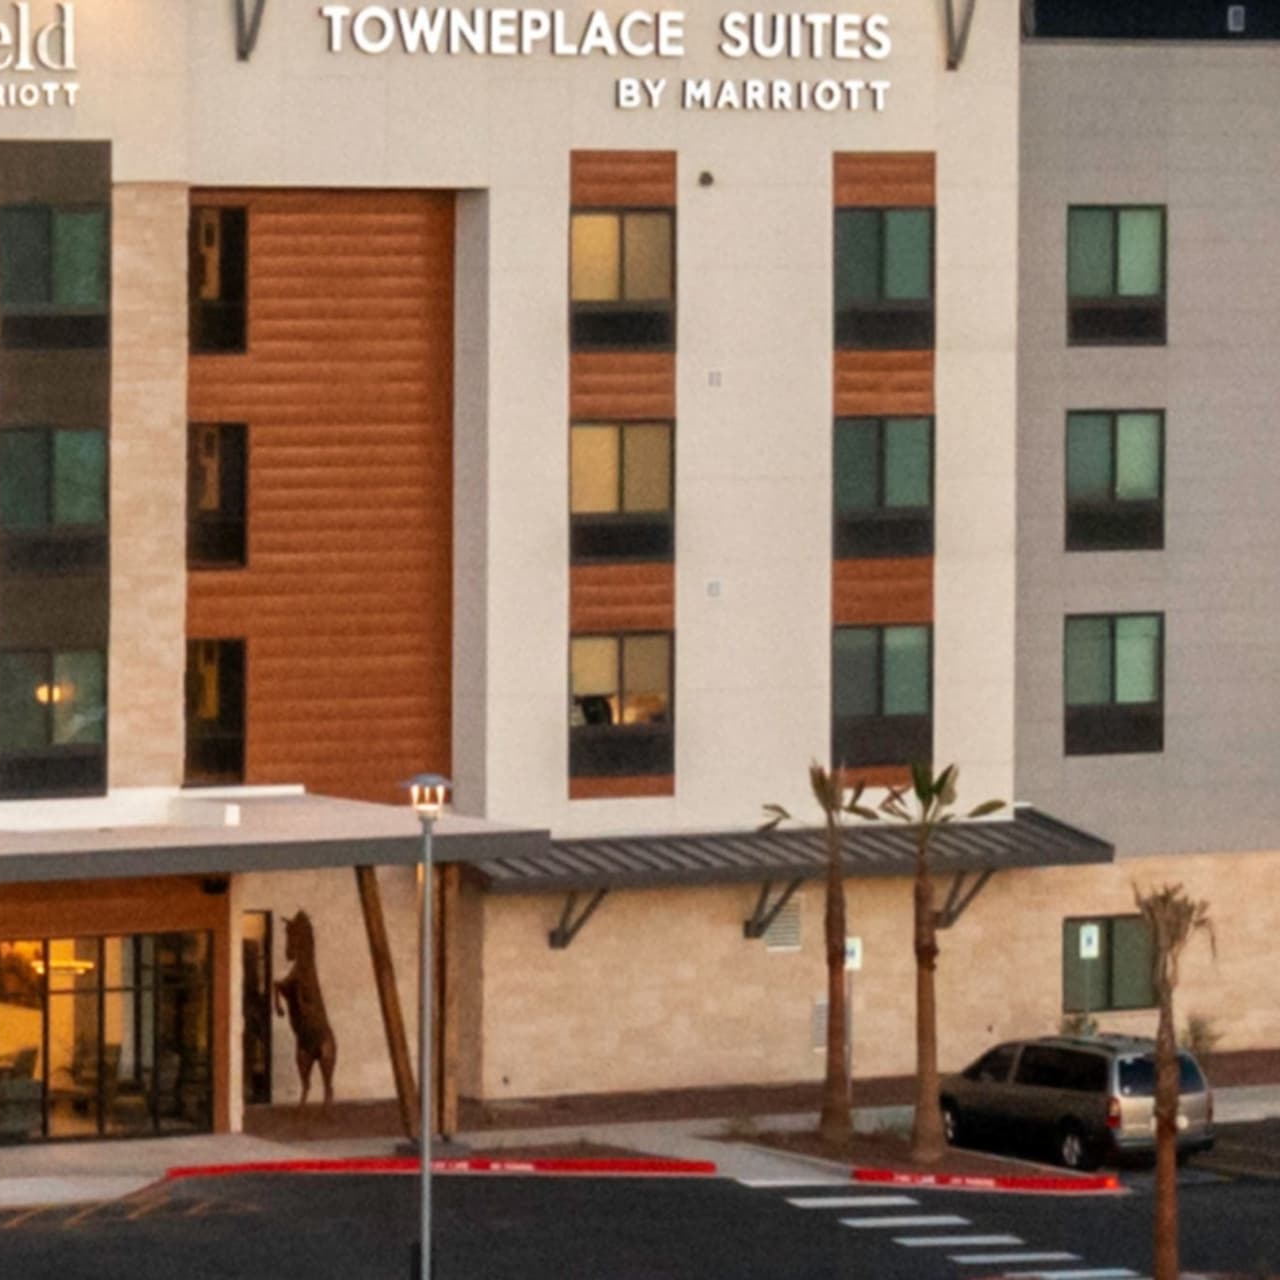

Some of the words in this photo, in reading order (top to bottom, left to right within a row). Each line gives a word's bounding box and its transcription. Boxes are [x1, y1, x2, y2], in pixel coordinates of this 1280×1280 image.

[320, 5, 686, 58] TOWNEPLACE
[718, 11, 892, 59] SUITES
[615, 78, 666, 109] BY
[682, 78, 891, 112] MARRIOTT
